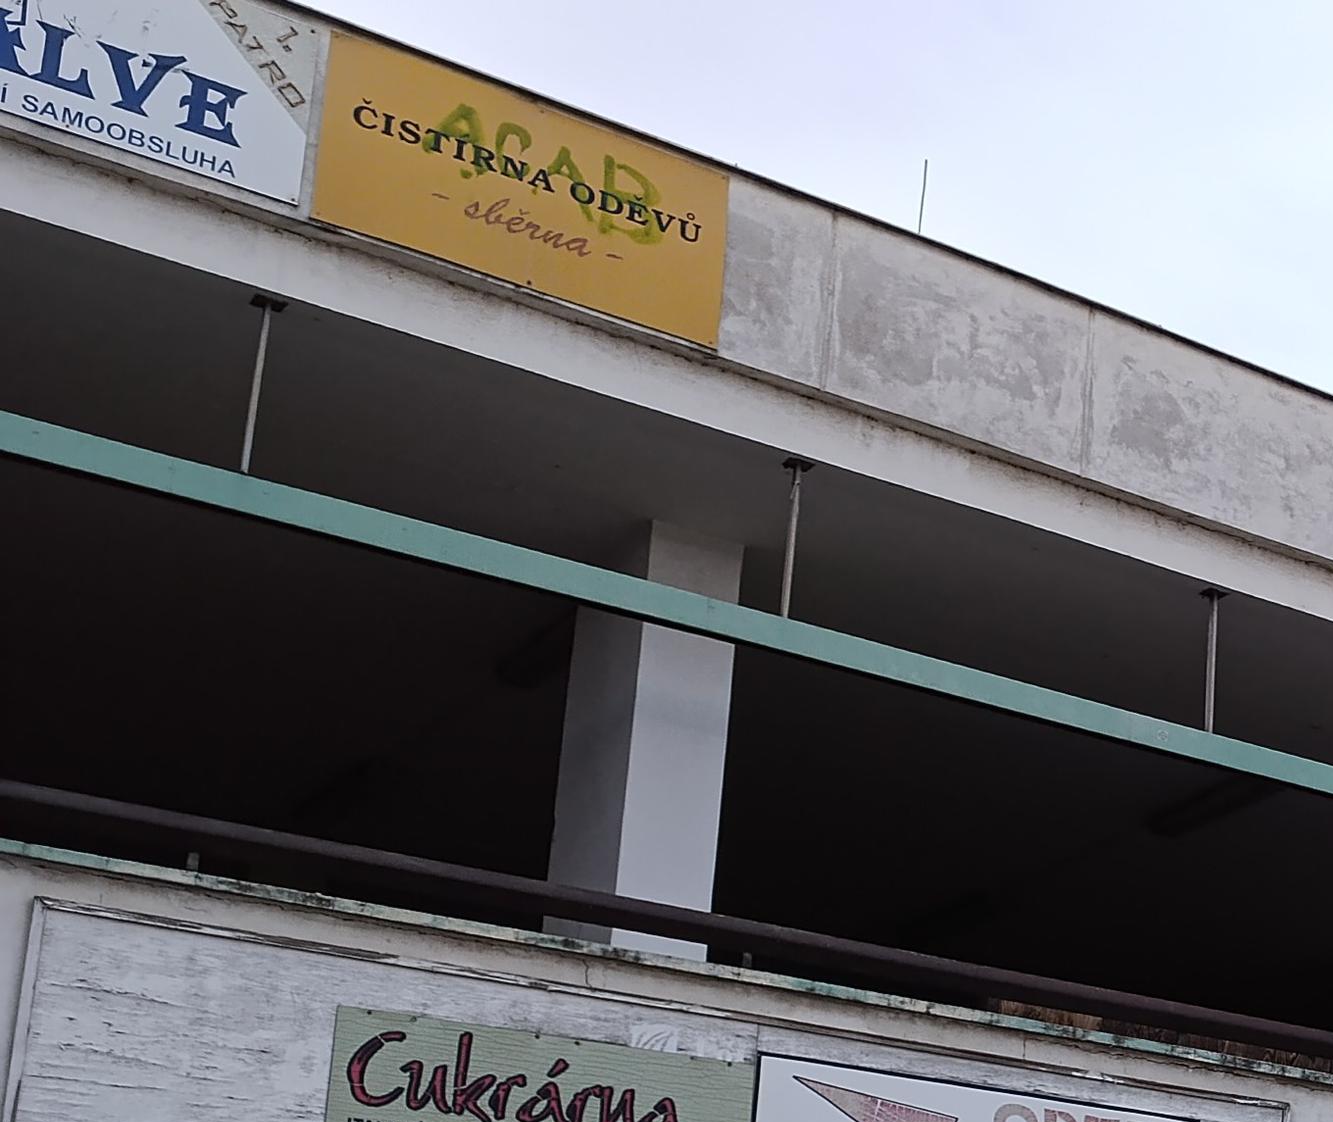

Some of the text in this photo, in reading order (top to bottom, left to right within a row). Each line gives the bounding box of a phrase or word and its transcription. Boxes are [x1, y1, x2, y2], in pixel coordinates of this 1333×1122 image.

[21, 94, 236, 178] SAMOOBSLUHA
[352, 97, 703, 245] ČISTÍRNA ODĚVŮ
[463, 198, 592, 260] sběrna
